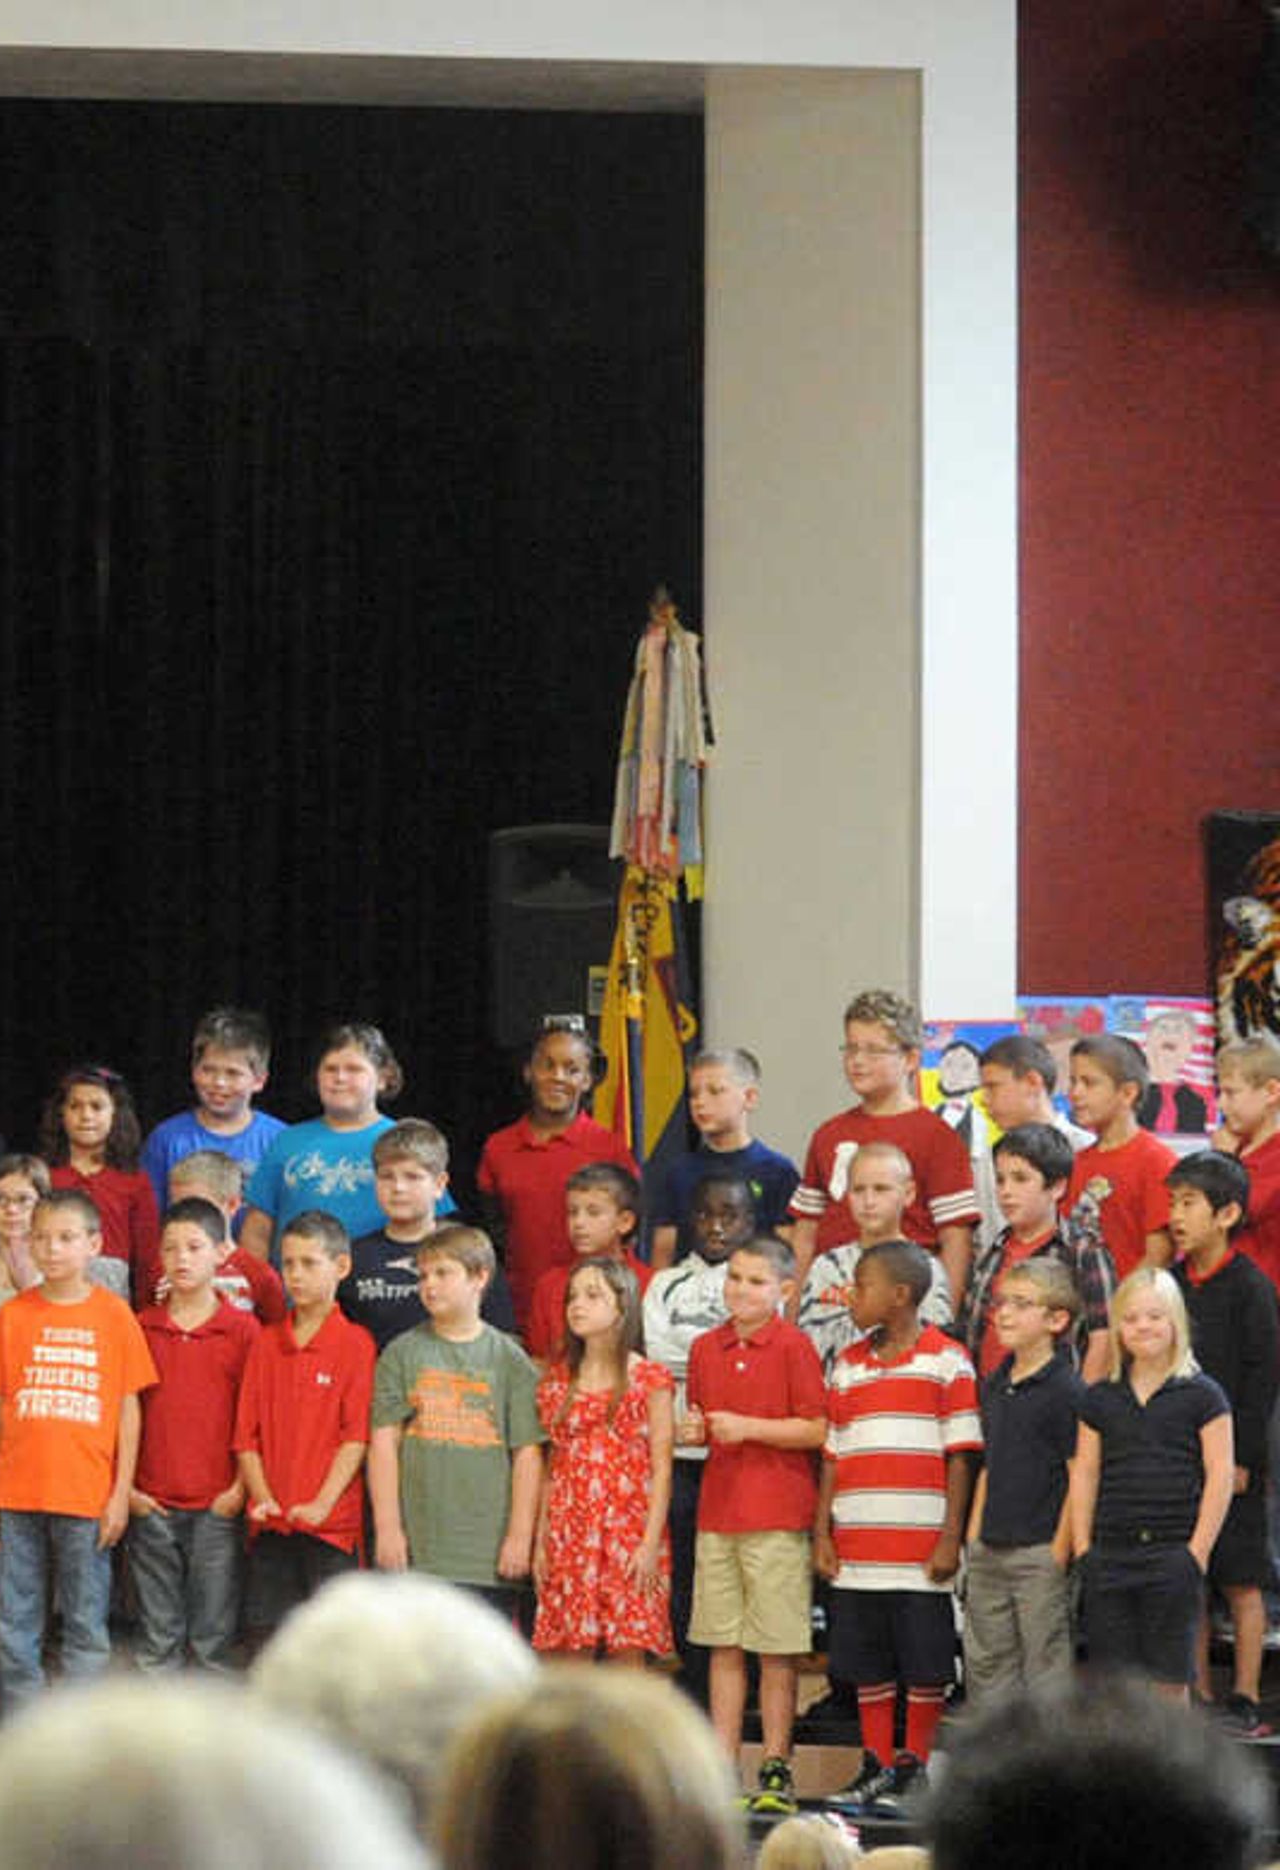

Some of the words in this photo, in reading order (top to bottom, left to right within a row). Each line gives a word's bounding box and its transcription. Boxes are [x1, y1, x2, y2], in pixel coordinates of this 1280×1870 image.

[32, 1345, 99, 1367] TIGERS
[22, 1366, 101, 1391] TIGERS
[16, 1388, 101, 1425] TIGERS
